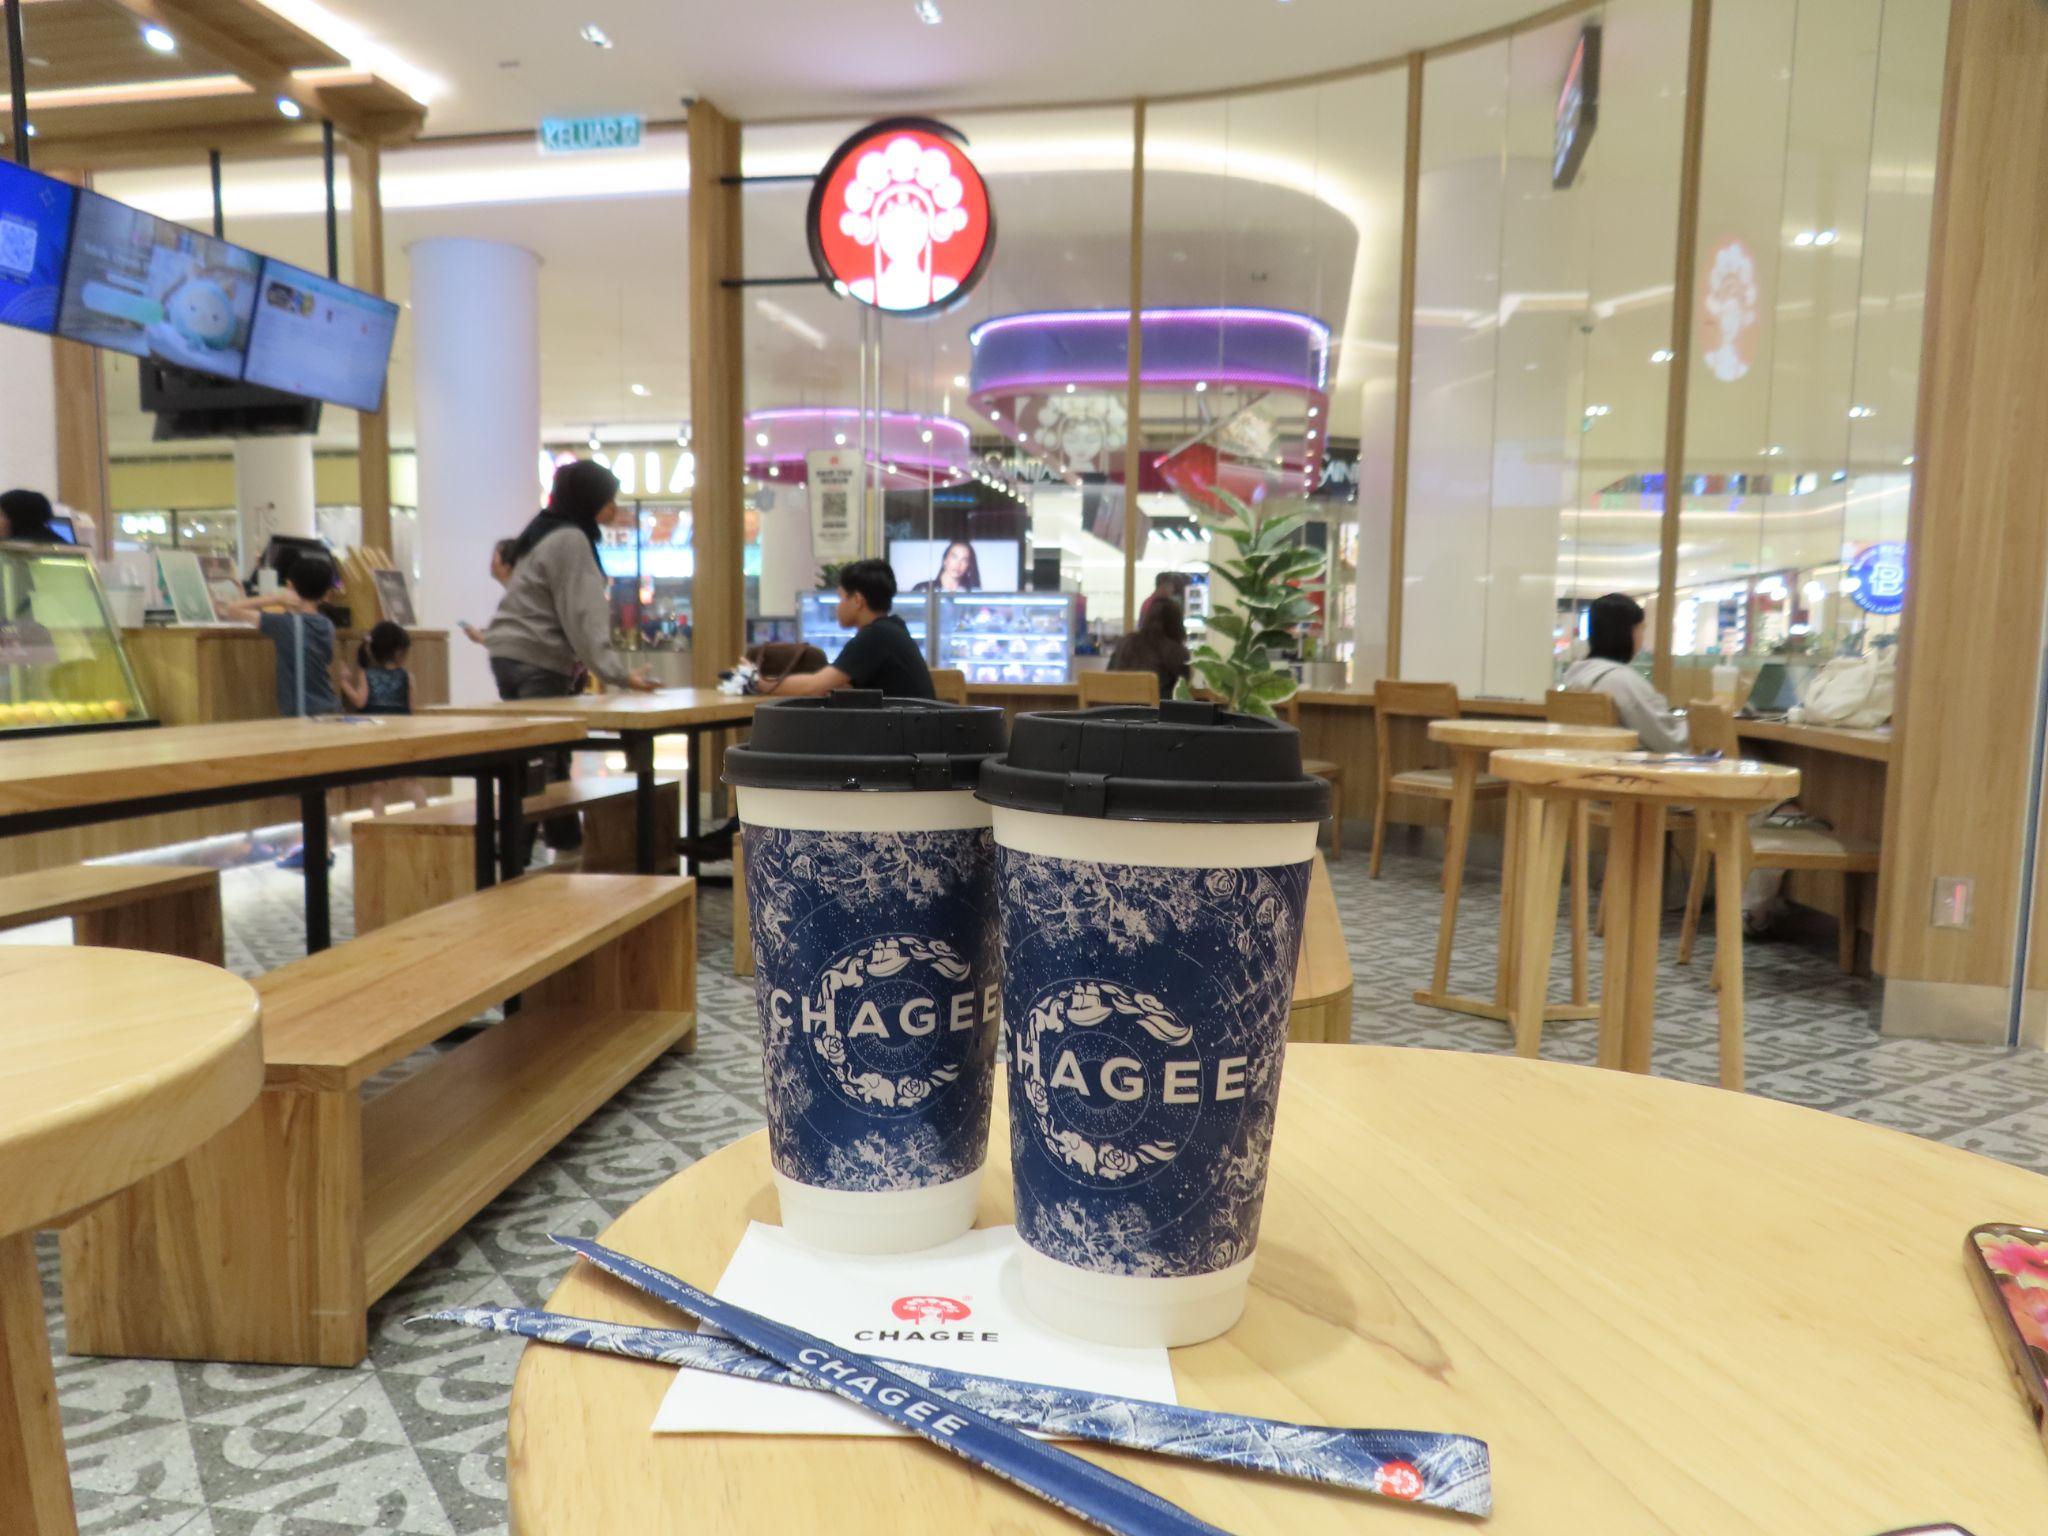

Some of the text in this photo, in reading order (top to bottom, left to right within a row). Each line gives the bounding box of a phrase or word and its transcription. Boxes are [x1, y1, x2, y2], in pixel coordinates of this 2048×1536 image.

[545, 119, 618, 150] KELUAR
[770, 983, 999, 1039] CHAGEE
[854, 1330, 999, 1343] CHAGEE
[798, 1348, 969, 1437] CHAGEE
